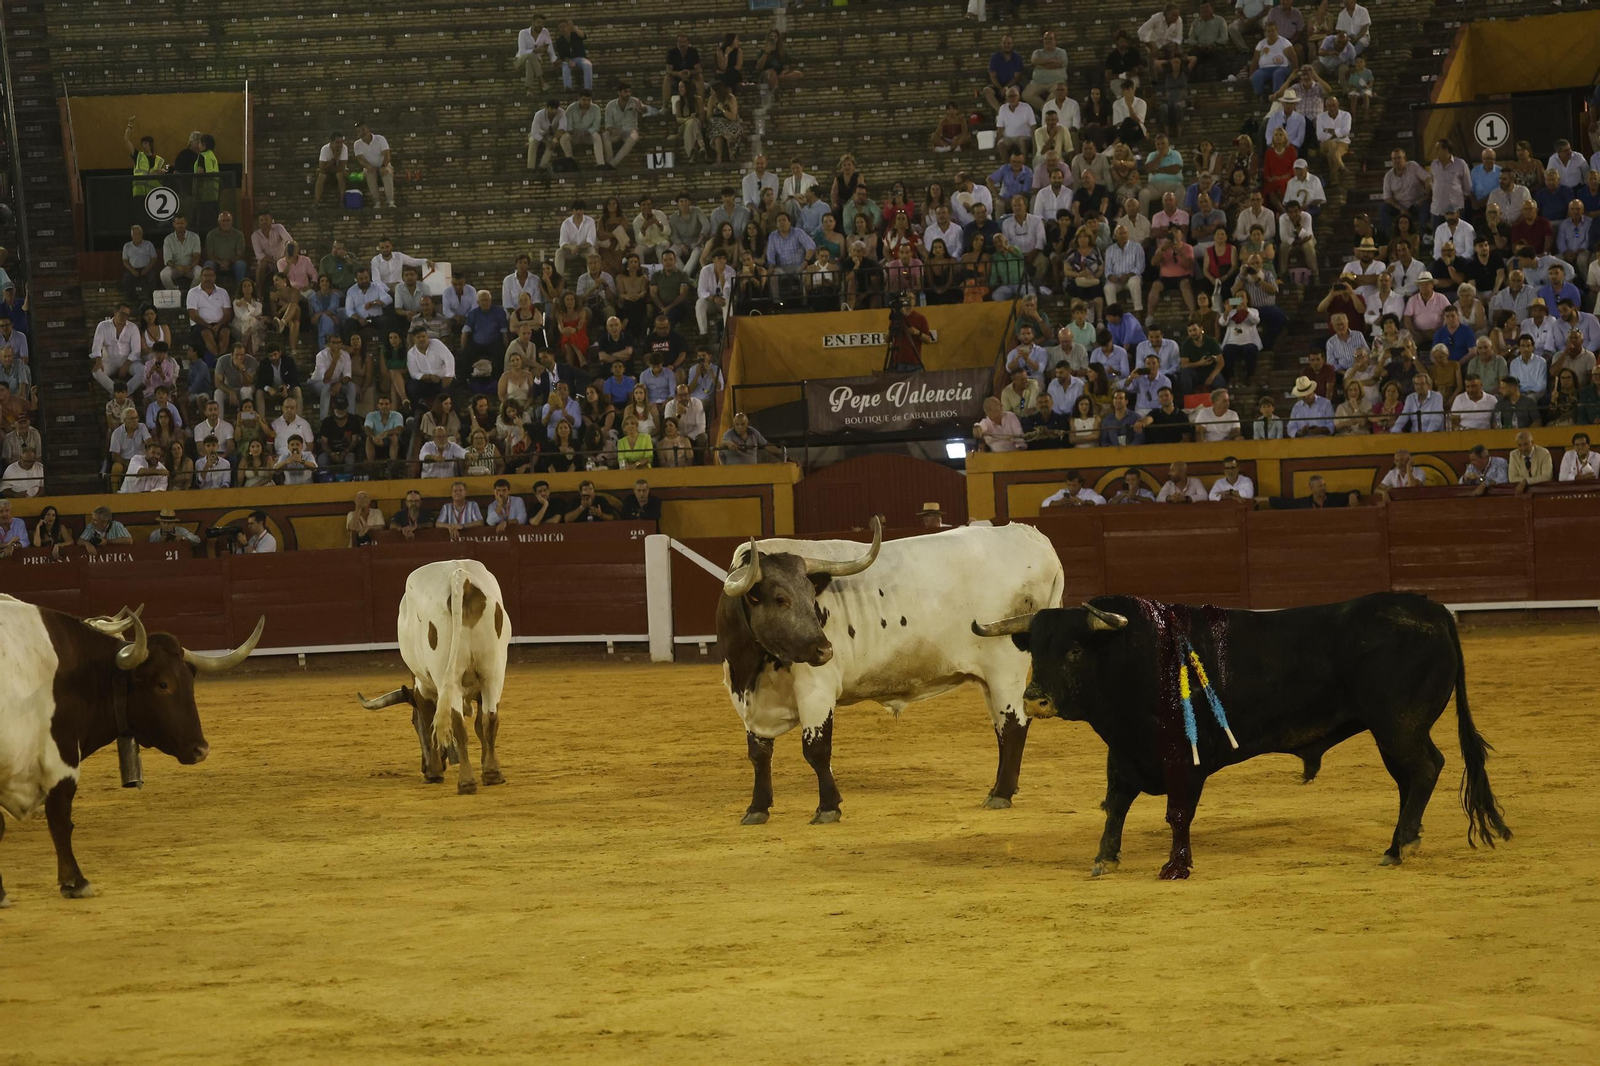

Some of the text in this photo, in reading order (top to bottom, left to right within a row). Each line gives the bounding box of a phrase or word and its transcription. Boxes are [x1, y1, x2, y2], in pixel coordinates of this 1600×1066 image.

[1486, 119, 1498, 141] 1
[155, 193, 169, 215] 2
[828, 381, 973, 413] Pepe Valencia
[844, 414, 890, 425] BOUTIQUE
[903, 409, 958, 420] CABALLEROS
[518, 532, 564, 543] MEDICO
[80, 552, 134, 563] RAFICA
[165, 550, 179, 560] 21
